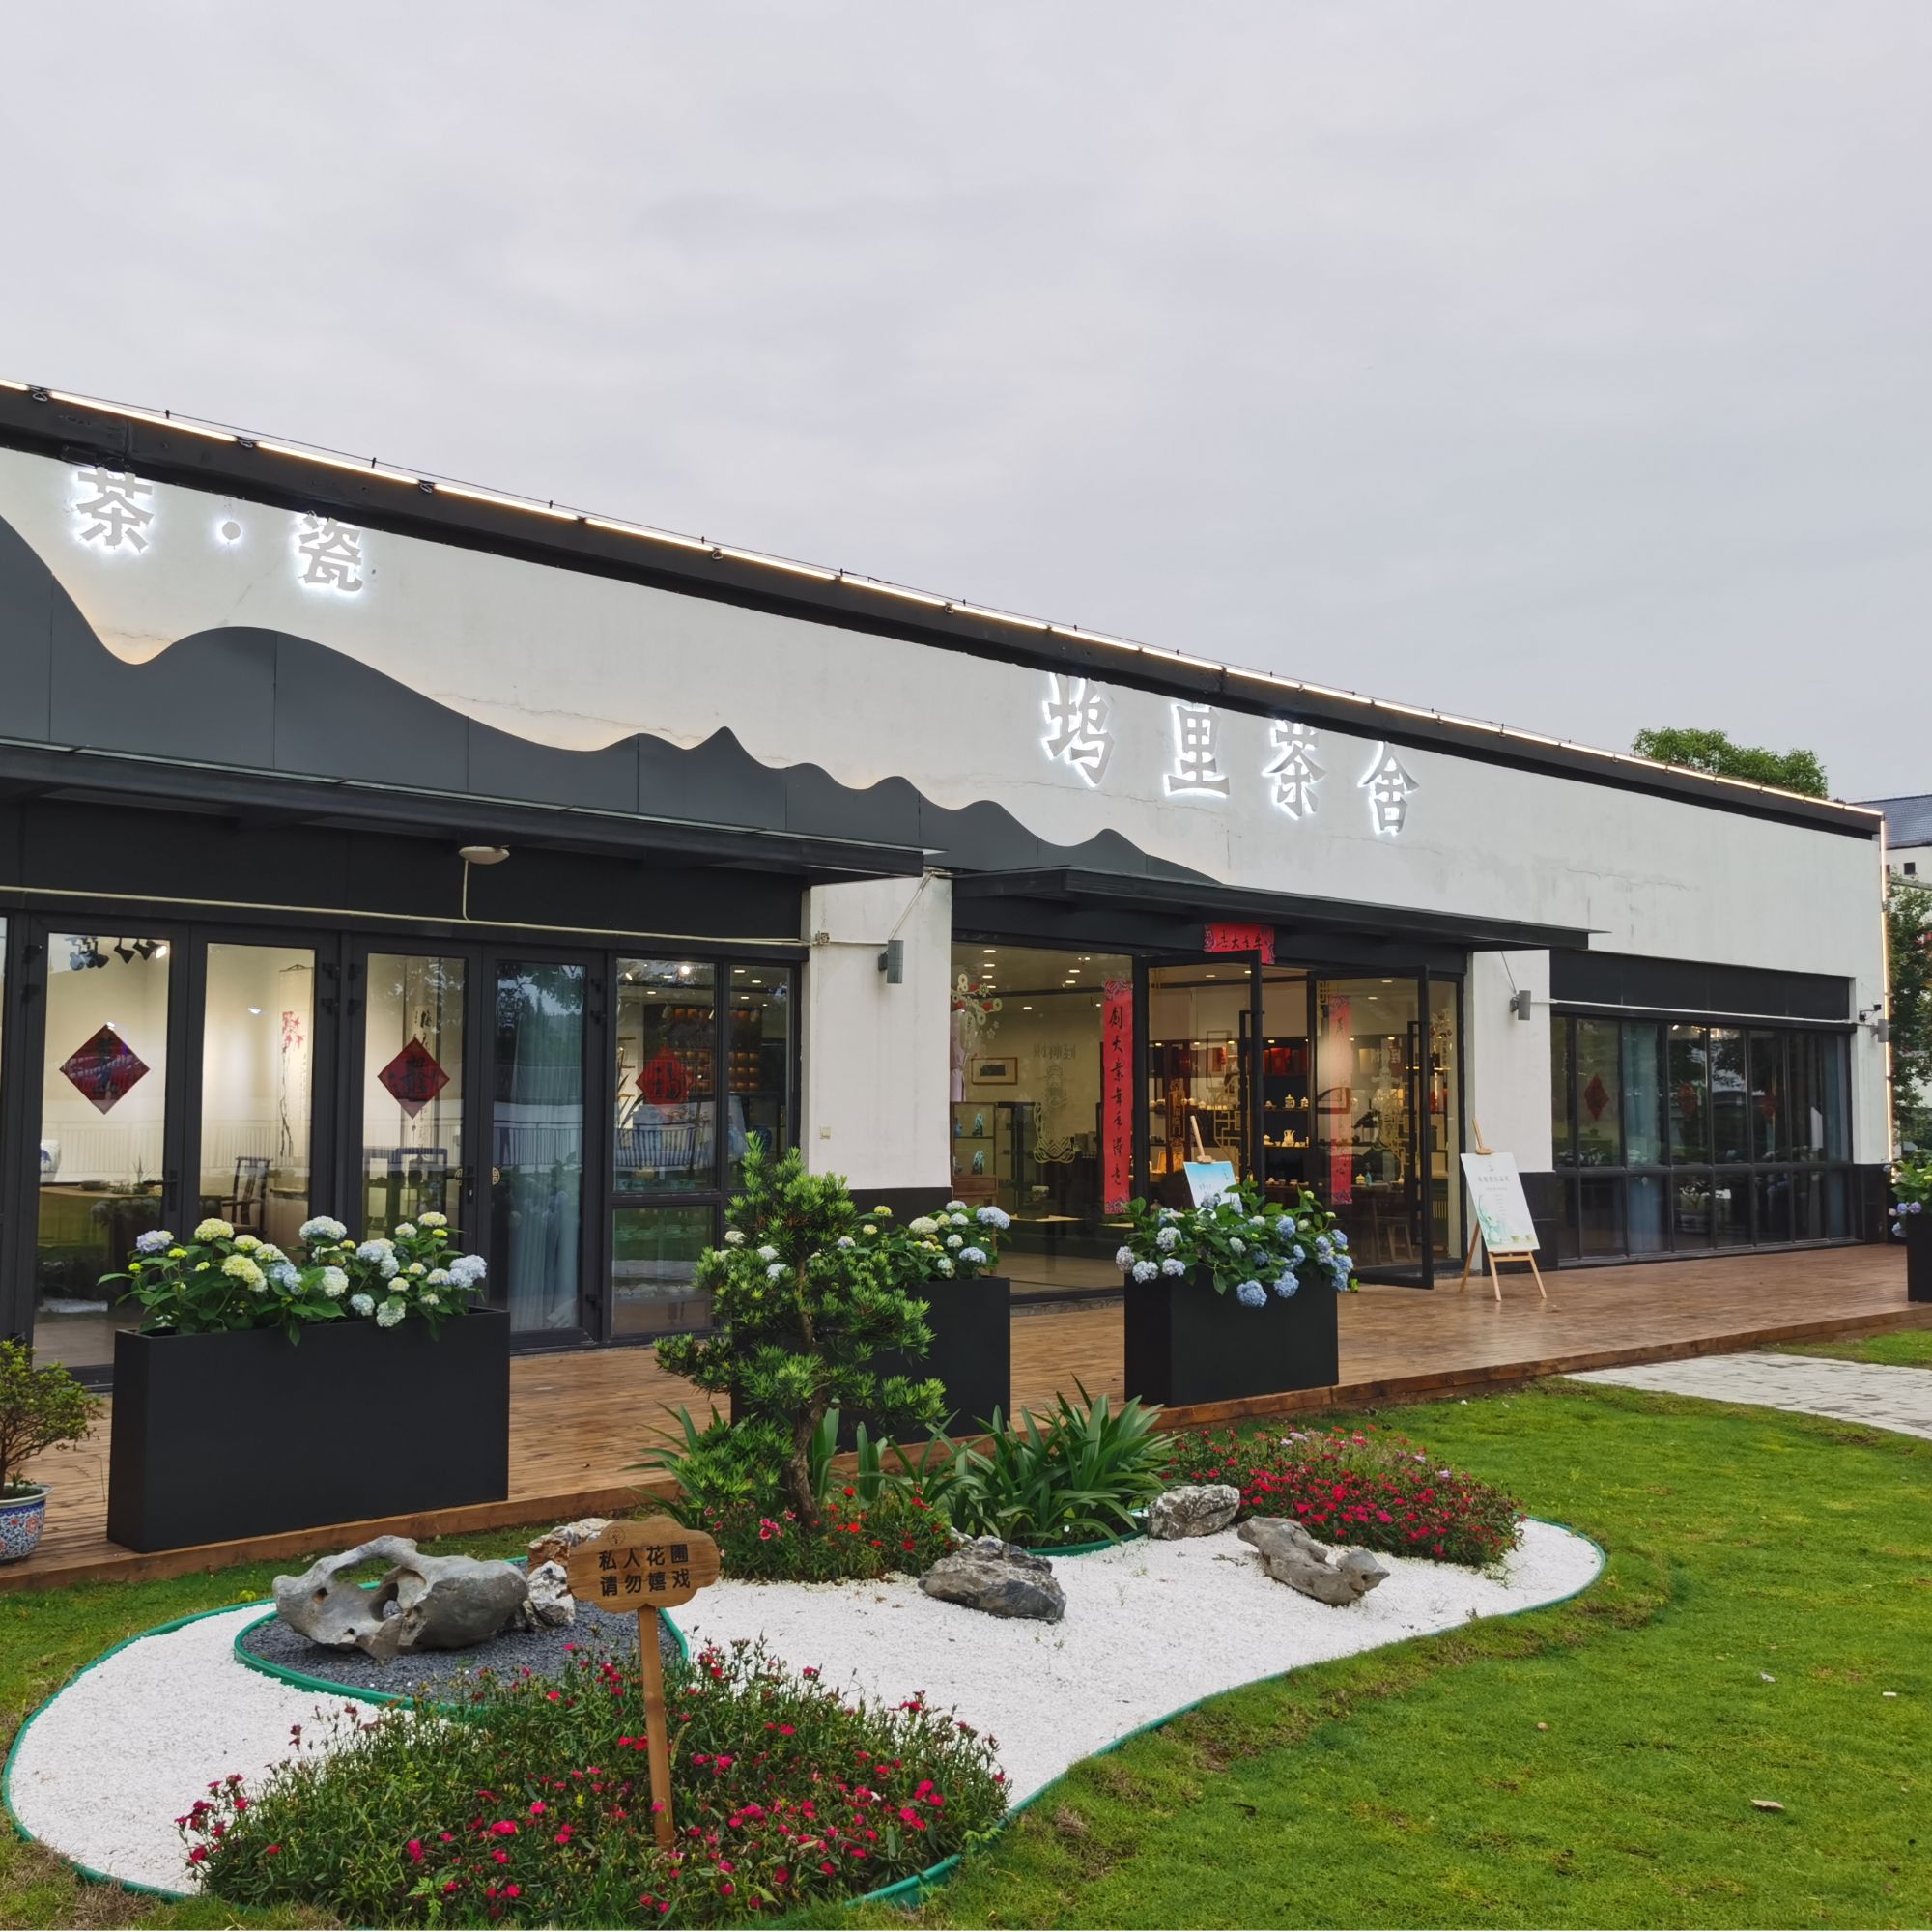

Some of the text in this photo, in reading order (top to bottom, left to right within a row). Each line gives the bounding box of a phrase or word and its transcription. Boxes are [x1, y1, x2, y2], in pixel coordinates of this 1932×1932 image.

[1046, 672, 1420, 836] 坞里茶舍
[600, 1568, 692, 1597] 请勿嬉戏
